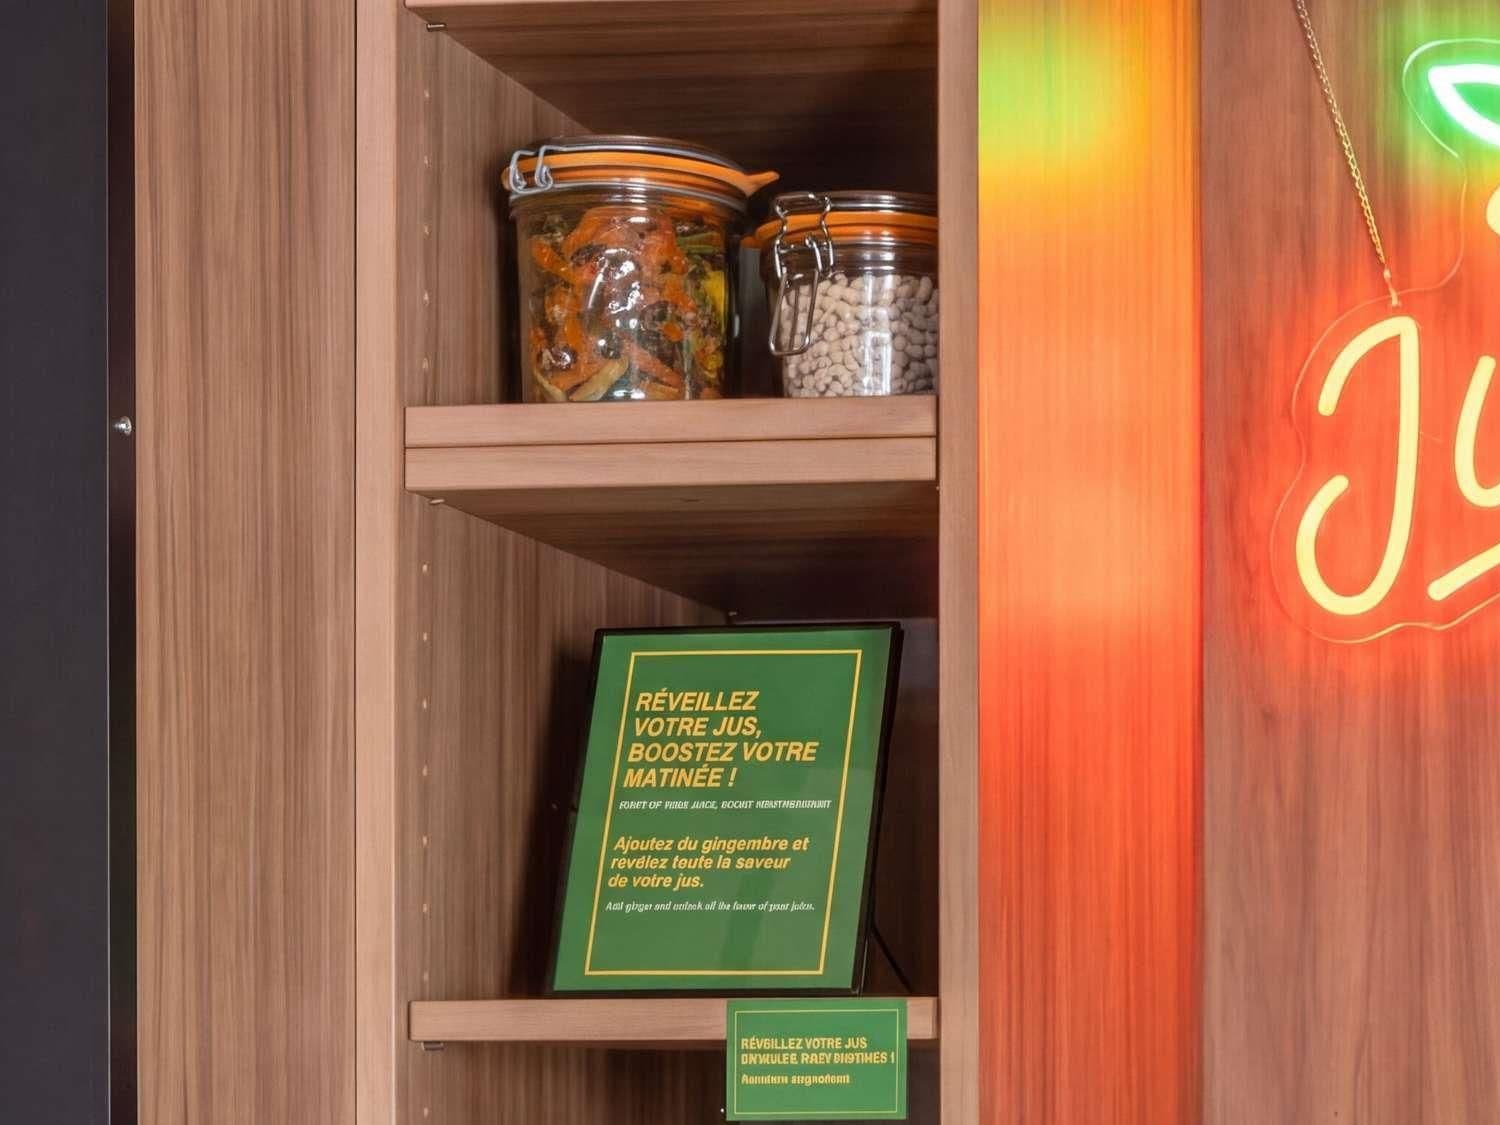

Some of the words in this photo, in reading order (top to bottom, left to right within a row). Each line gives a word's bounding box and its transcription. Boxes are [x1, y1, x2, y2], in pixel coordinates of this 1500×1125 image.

[635, 687, 760, 711] RÉVEILLEZ
[635, 717, 709, 737] VOTRE
[713, 716, 762, 739] JUS,
[628, 742, 738, 762] BOOSTEZ
[743, 741, 819, 762] VOTRE
[624, 763, 724, 788] MATINÉE
[728, 767, 738, 787] !
[614, 836, 673, 855] Ajoutez
[677, 836, 697, 851] du
[702, 836, 788, 855] gingembre
[717, 855, 731, 869] la
[735, 857, 792, 869] saveur
[608, 873, 628, 888] de
[633, 874, 673, 888] votre
[673, 873, 704, 891] jus.
[805, 1037, 842, 1049] VOTRE
[844, 1036, 868, 1049] JUS
